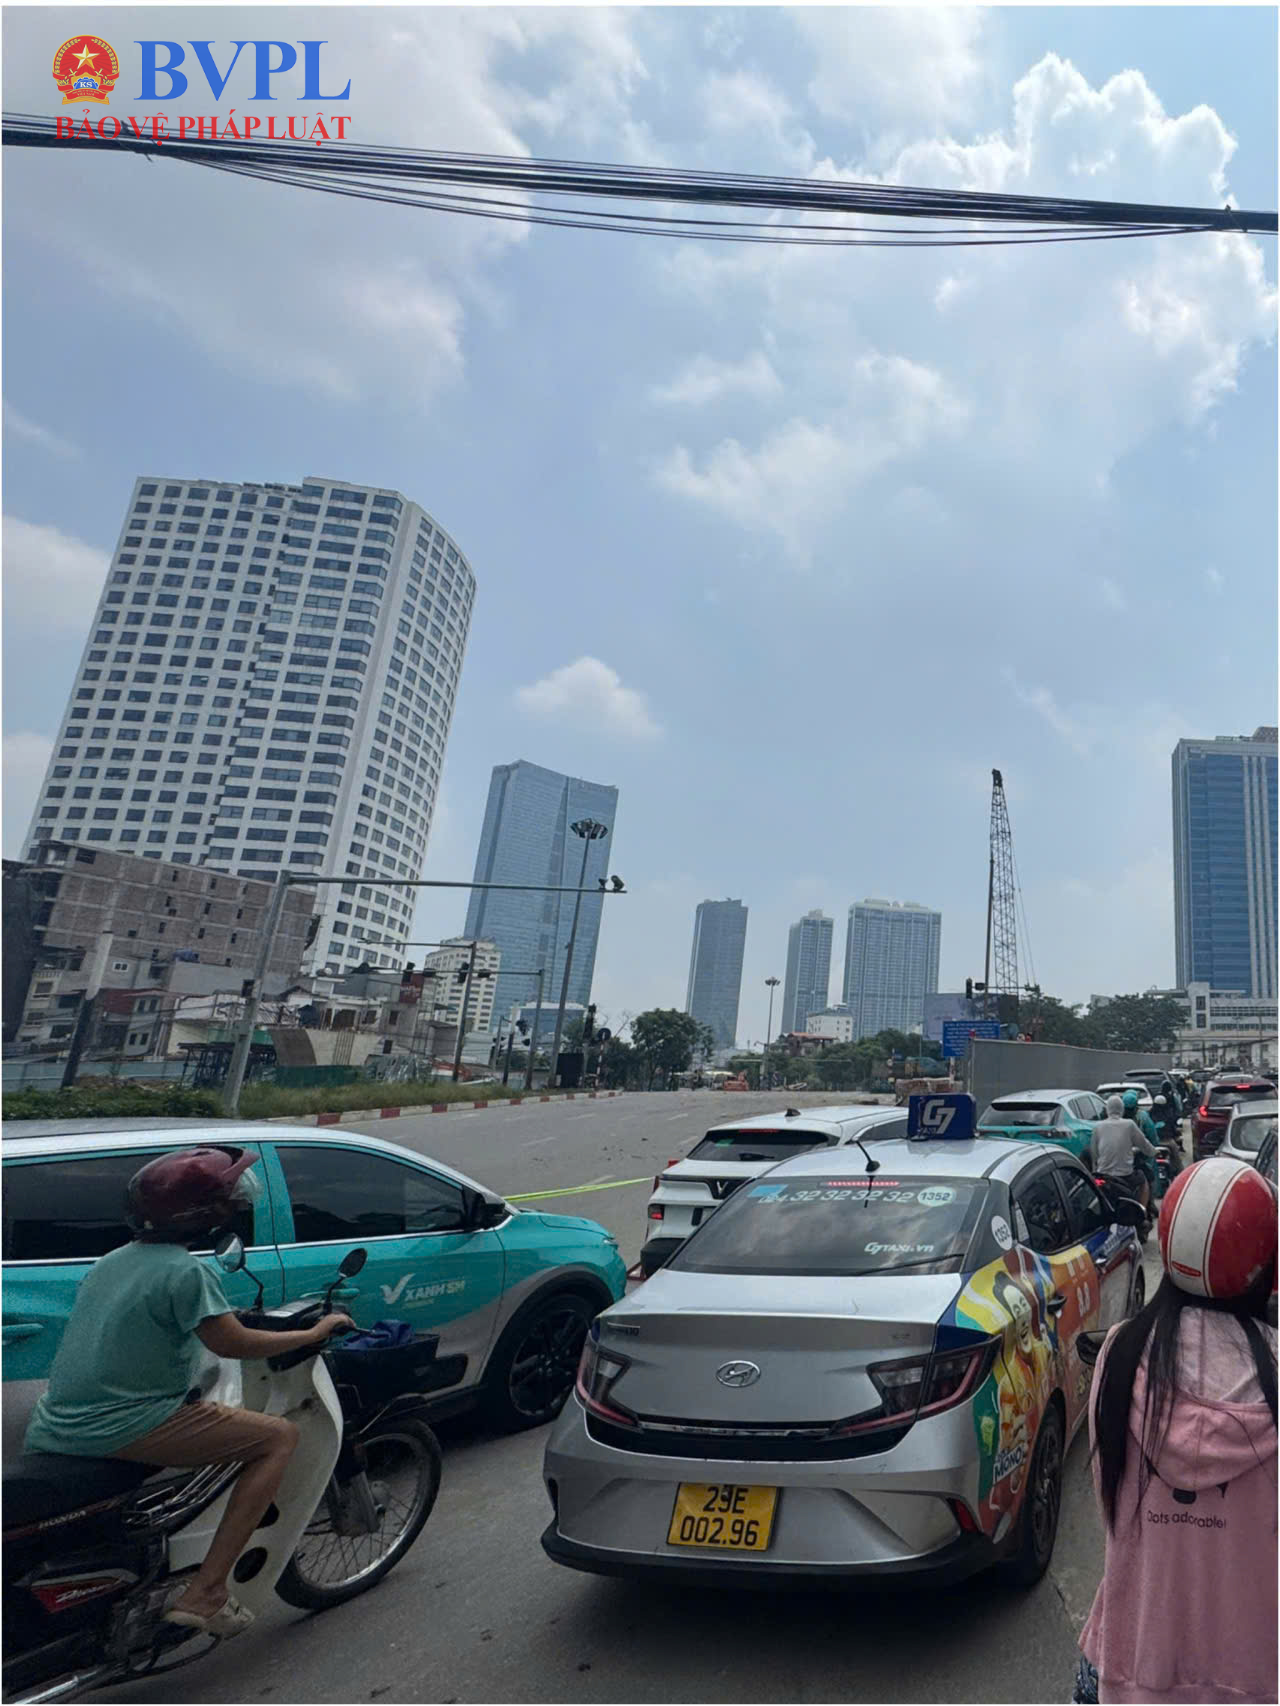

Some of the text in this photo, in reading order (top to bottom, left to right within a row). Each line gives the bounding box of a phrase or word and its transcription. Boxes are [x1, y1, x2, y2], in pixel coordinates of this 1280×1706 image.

[922, 1098, 957, 1135] G7
[820, 1190, 848, 1201] 32
[882, 1191, 914, 1203] 32
[922, 1191, 951, 1201] 1352
[680, 1515, 761, 1547] 002.96
